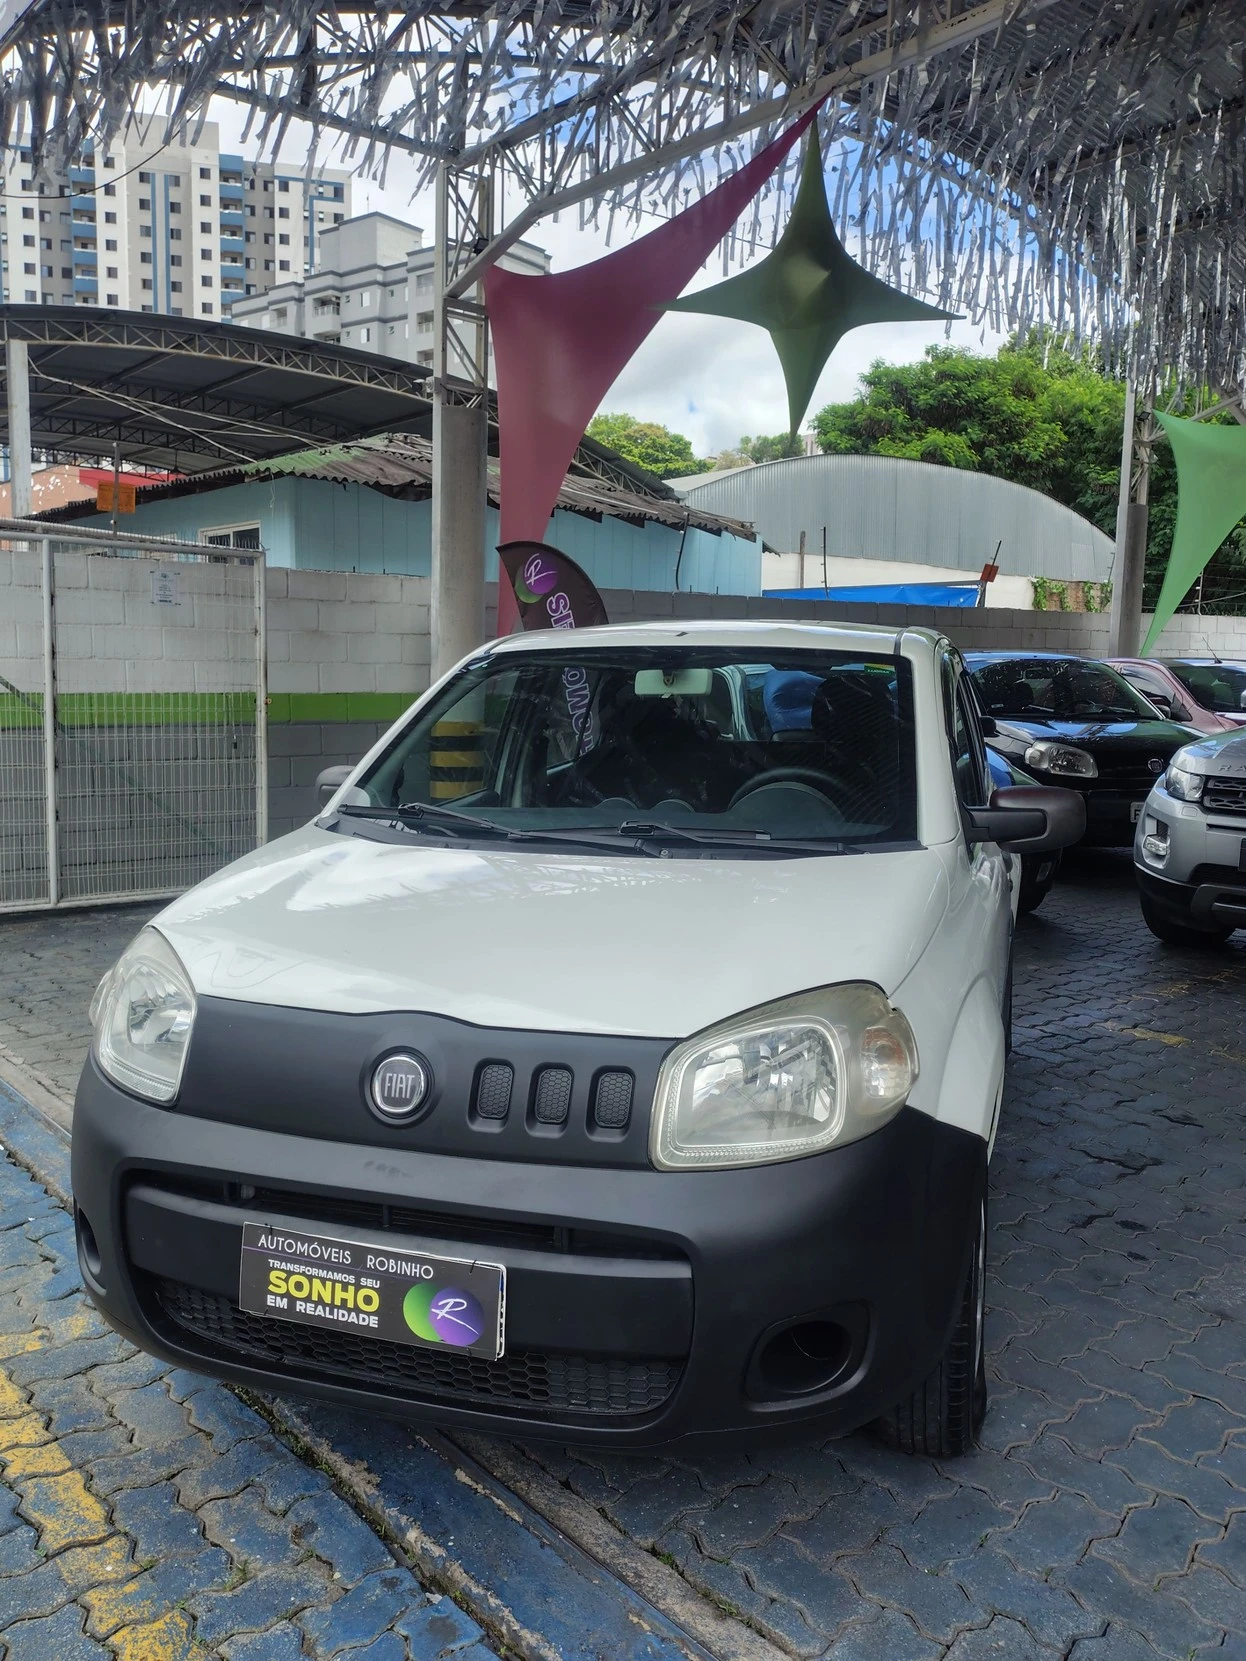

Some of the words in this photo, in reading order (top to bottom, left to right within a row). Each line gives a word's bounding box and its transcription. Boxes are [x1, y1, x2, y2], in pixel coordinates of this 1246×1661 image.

[384, 1072, 415, 1099] FIAT
[258, 1234, 351, 1264] AUTOMÓVEIS
[366, 1255, 434, 1280] ROBINHO
[268, 1259, 355, 1284] TRANSFORMAMOS
[360, 1277, 380, 1289] SEU
[267, 1270, 380, 1313] SONHO
[266, 1294, 288, 1310] EM
[295, 1300, 379, 1328] REALIDADE
